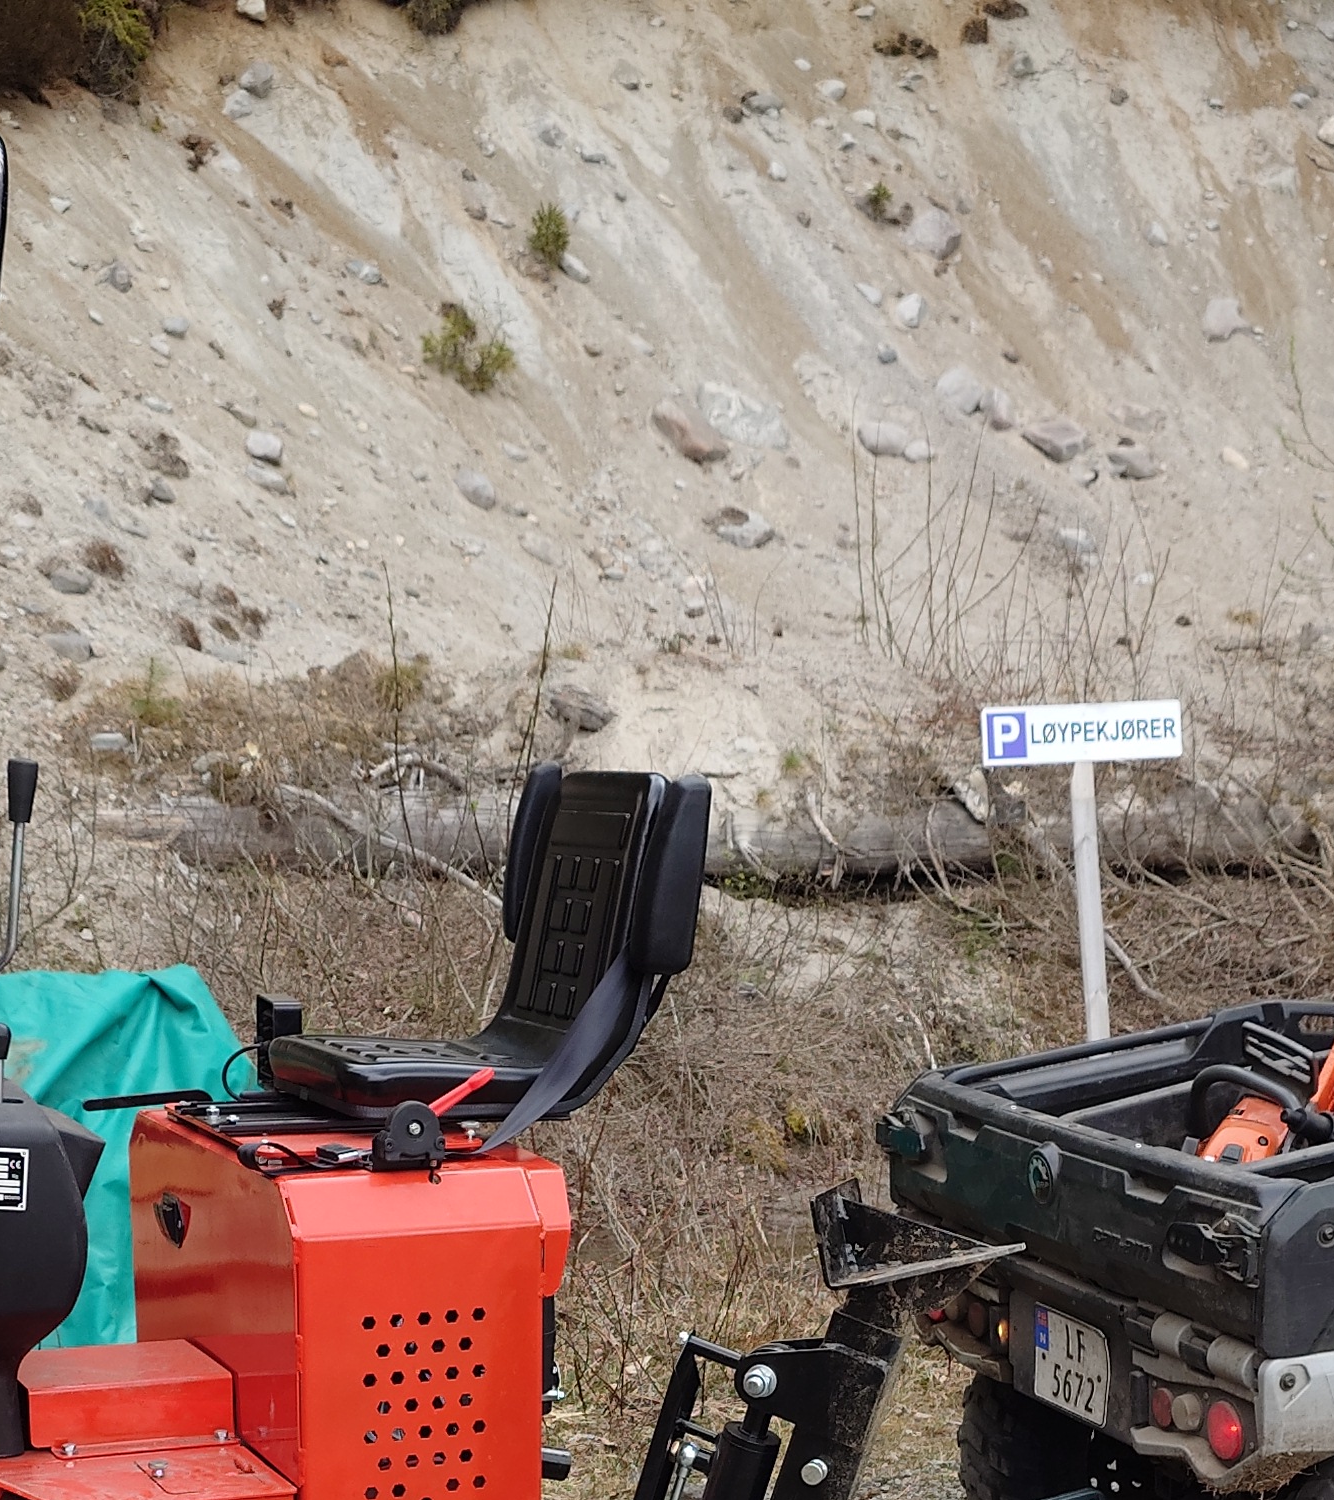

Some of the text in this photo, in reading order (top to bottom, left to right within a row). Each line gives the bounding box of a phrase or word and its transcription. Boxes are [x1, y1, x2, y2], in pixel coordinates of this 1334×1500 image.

[992, 715, 1177, 757] P LØYPEKJØRER
[1065, 1323, 1086, 1363] LF
[1052, 1362, 1095, 1414] 5672
